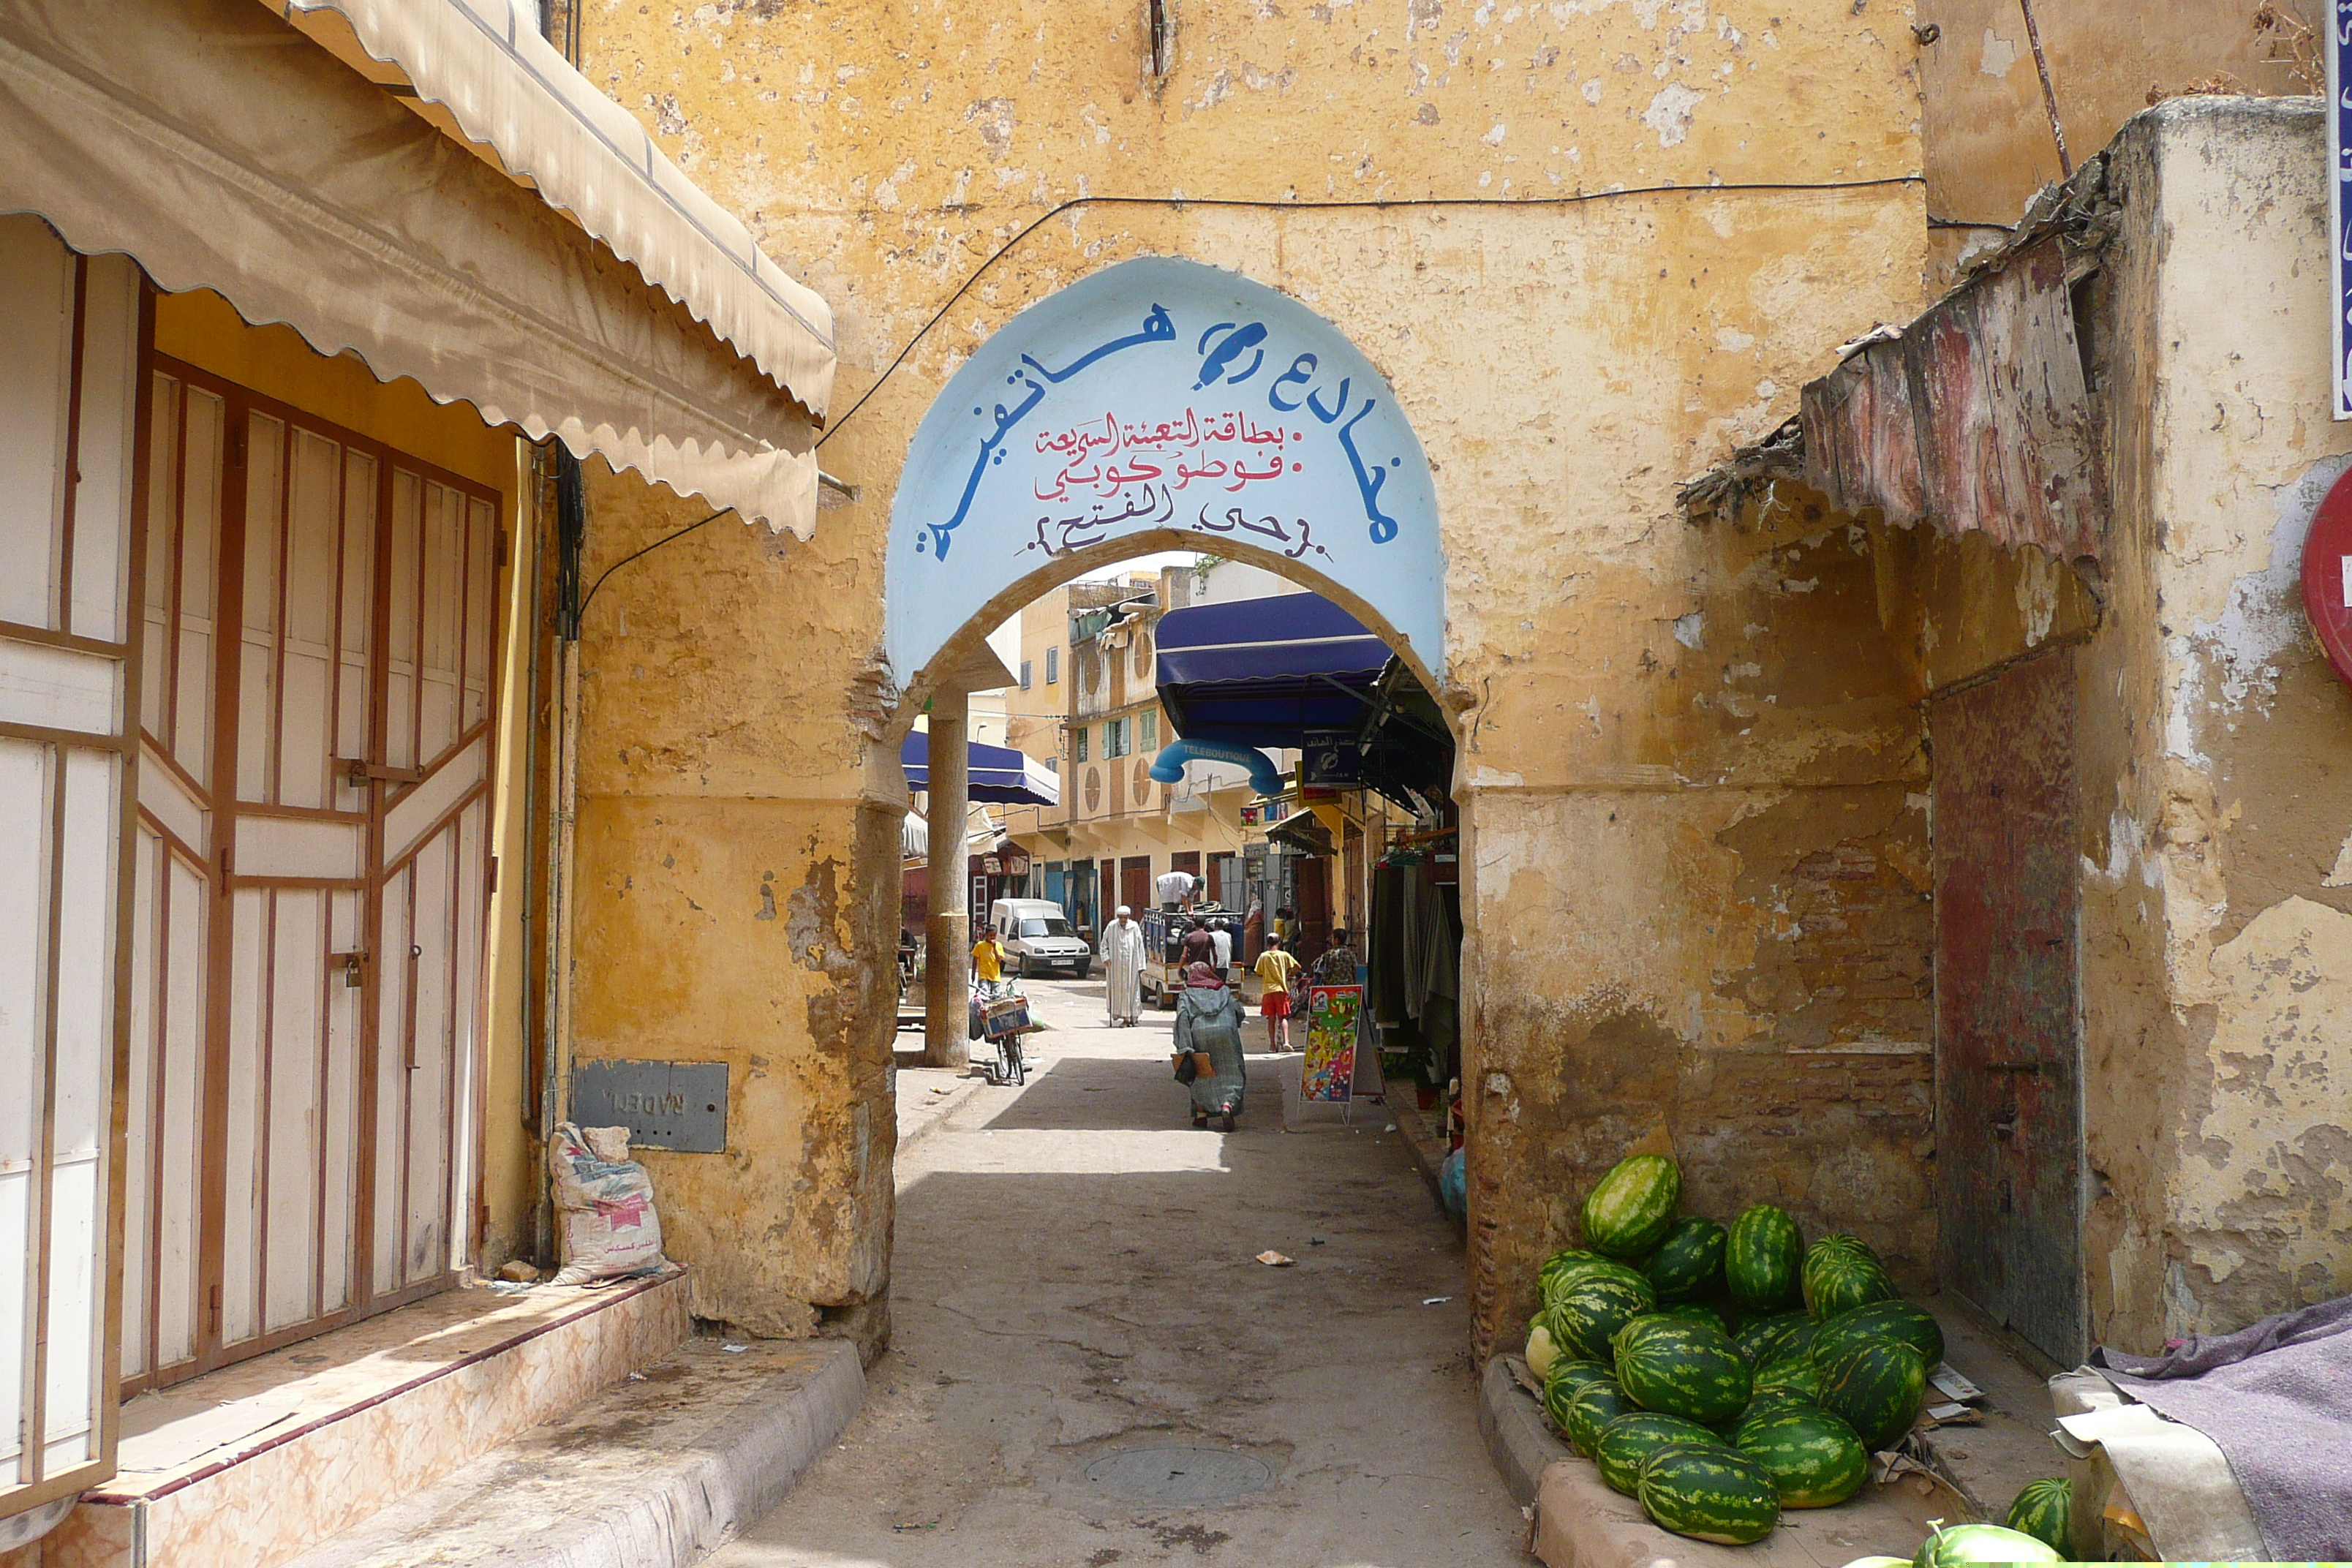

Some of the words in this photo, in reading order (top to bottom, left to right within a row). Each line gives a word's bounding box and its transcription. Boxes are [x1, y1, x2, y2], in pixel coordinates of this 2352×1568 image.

[1123, 406, 1199, 451] التعبئة
[1204, 410, 1284, 451] بطاقة
[1184, 745, 1252, 763] TELEBOUTIQUE
